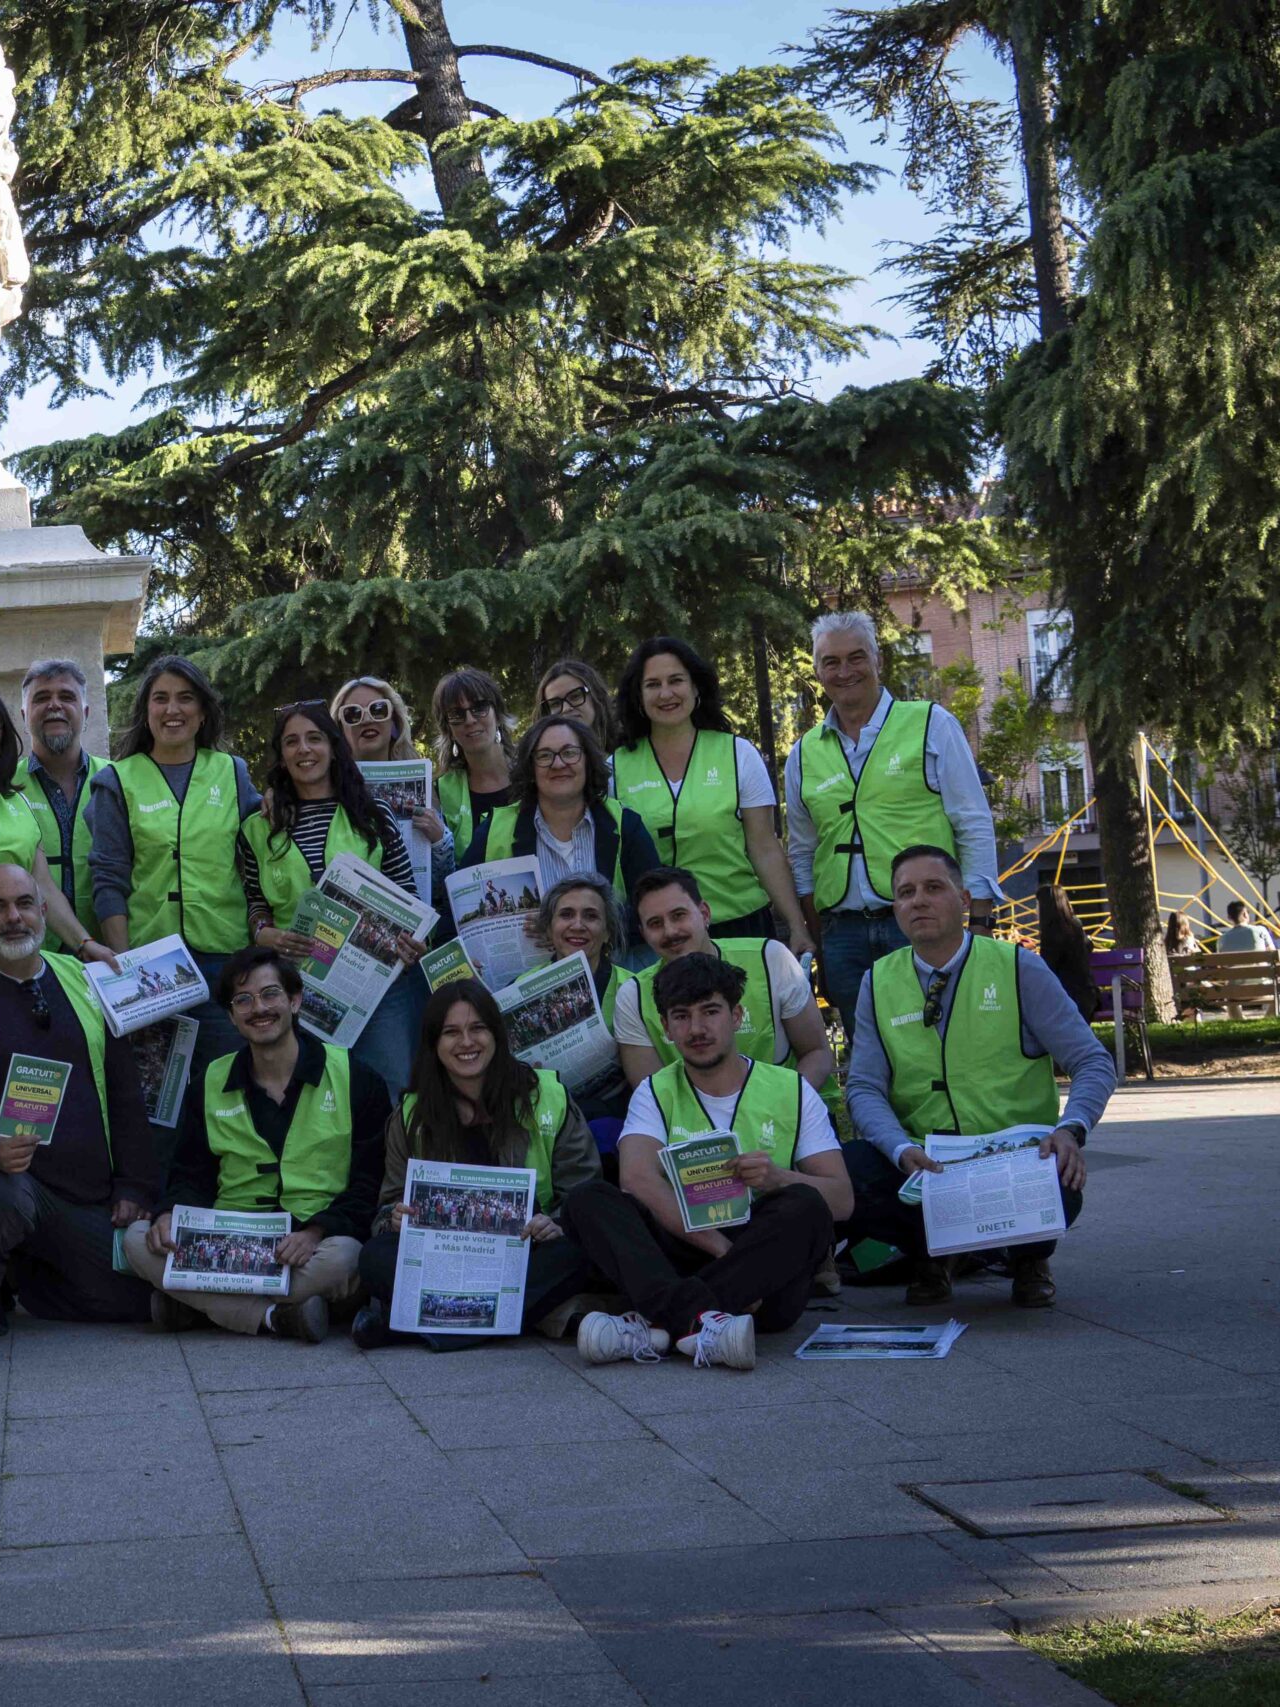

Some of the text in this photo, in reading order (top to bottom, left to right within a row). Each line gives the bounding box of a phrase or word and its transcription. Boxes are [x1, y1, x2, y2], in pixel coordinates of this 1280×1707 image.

[16, 1084, 53, 1097] UNIVERSAL
[694, 1178, 733, 1192] GRATUITO
[976, 1219, 1016, 1234] ÚNETE
[436, 1232, 497, 1245] Por qué votar
[442, 1242, 461, 1252] Más
[463, 1245, 496, 1255] Madrid
[231, 1276, 254, 1285] votar
